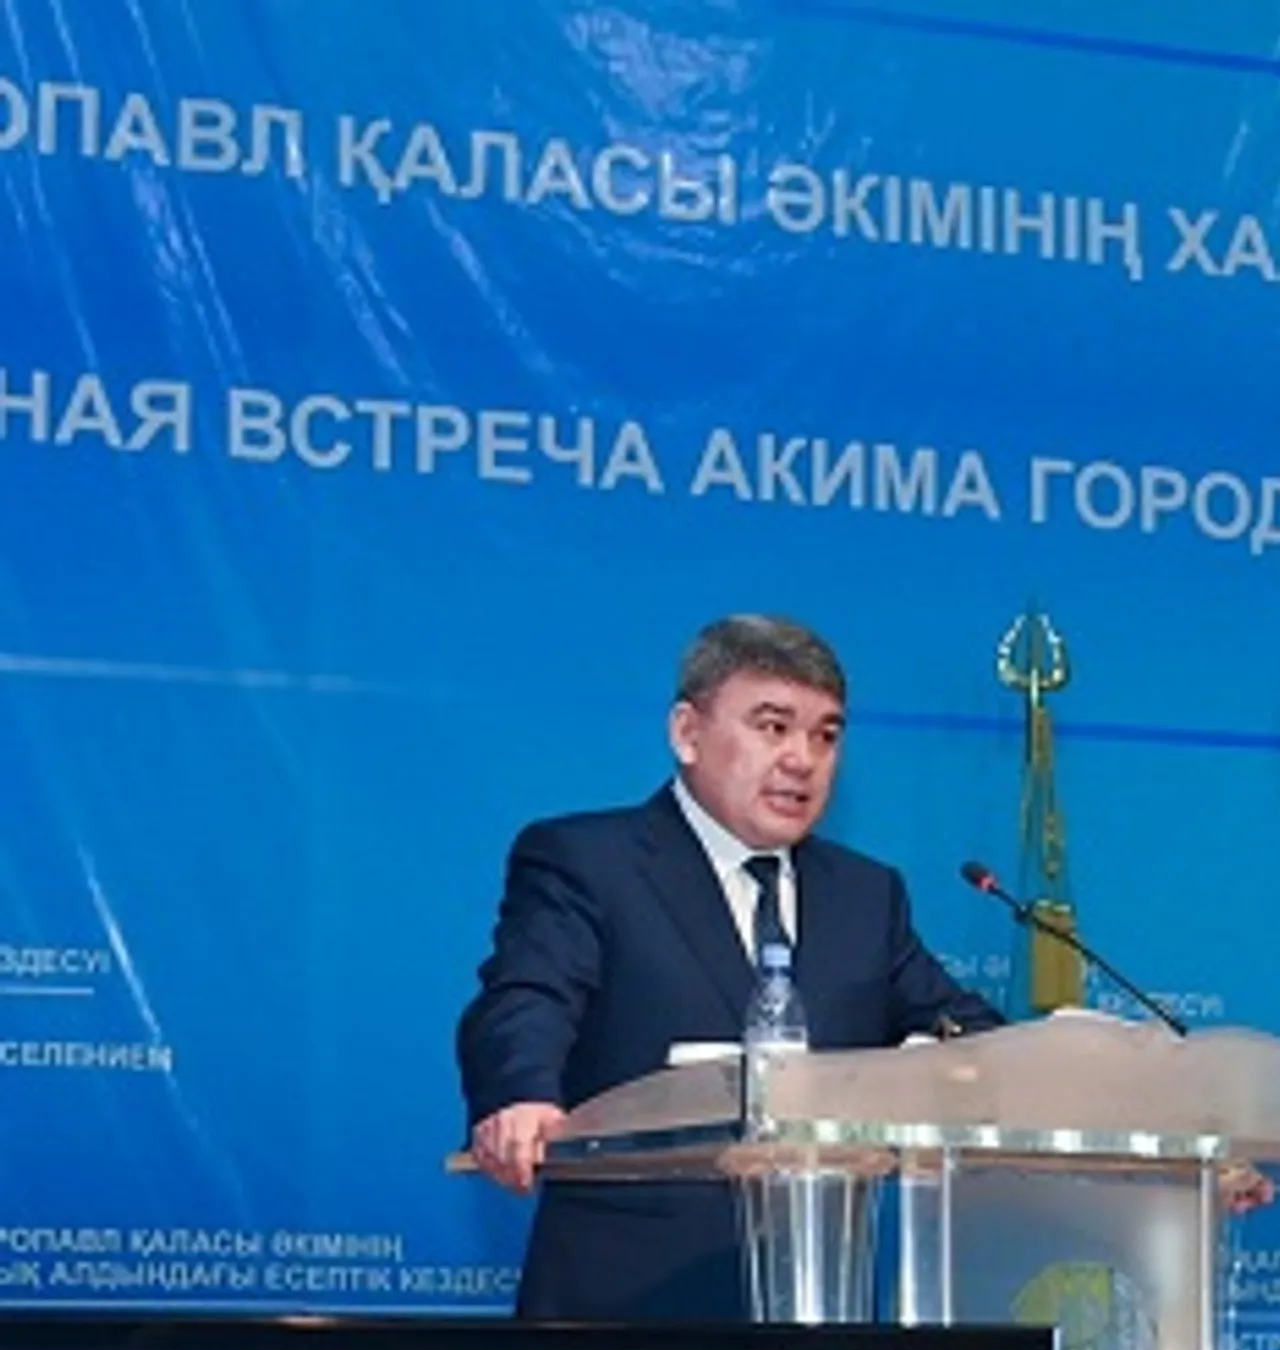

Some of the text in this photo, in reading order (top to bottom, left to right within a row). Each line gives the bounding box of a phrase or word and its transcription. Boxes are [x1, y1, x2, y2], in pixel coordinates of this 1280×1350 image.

[337, 115, 738, 225] ҚАЛАСЫ
[767, 164, 1143, 280] ӘКІМІНІҢ
[0, 366, 191, 453] НАЯ
[228, 388, 664, 494] ВСТРЕЧА
[690, 429, 1000, 519] АКИМА
